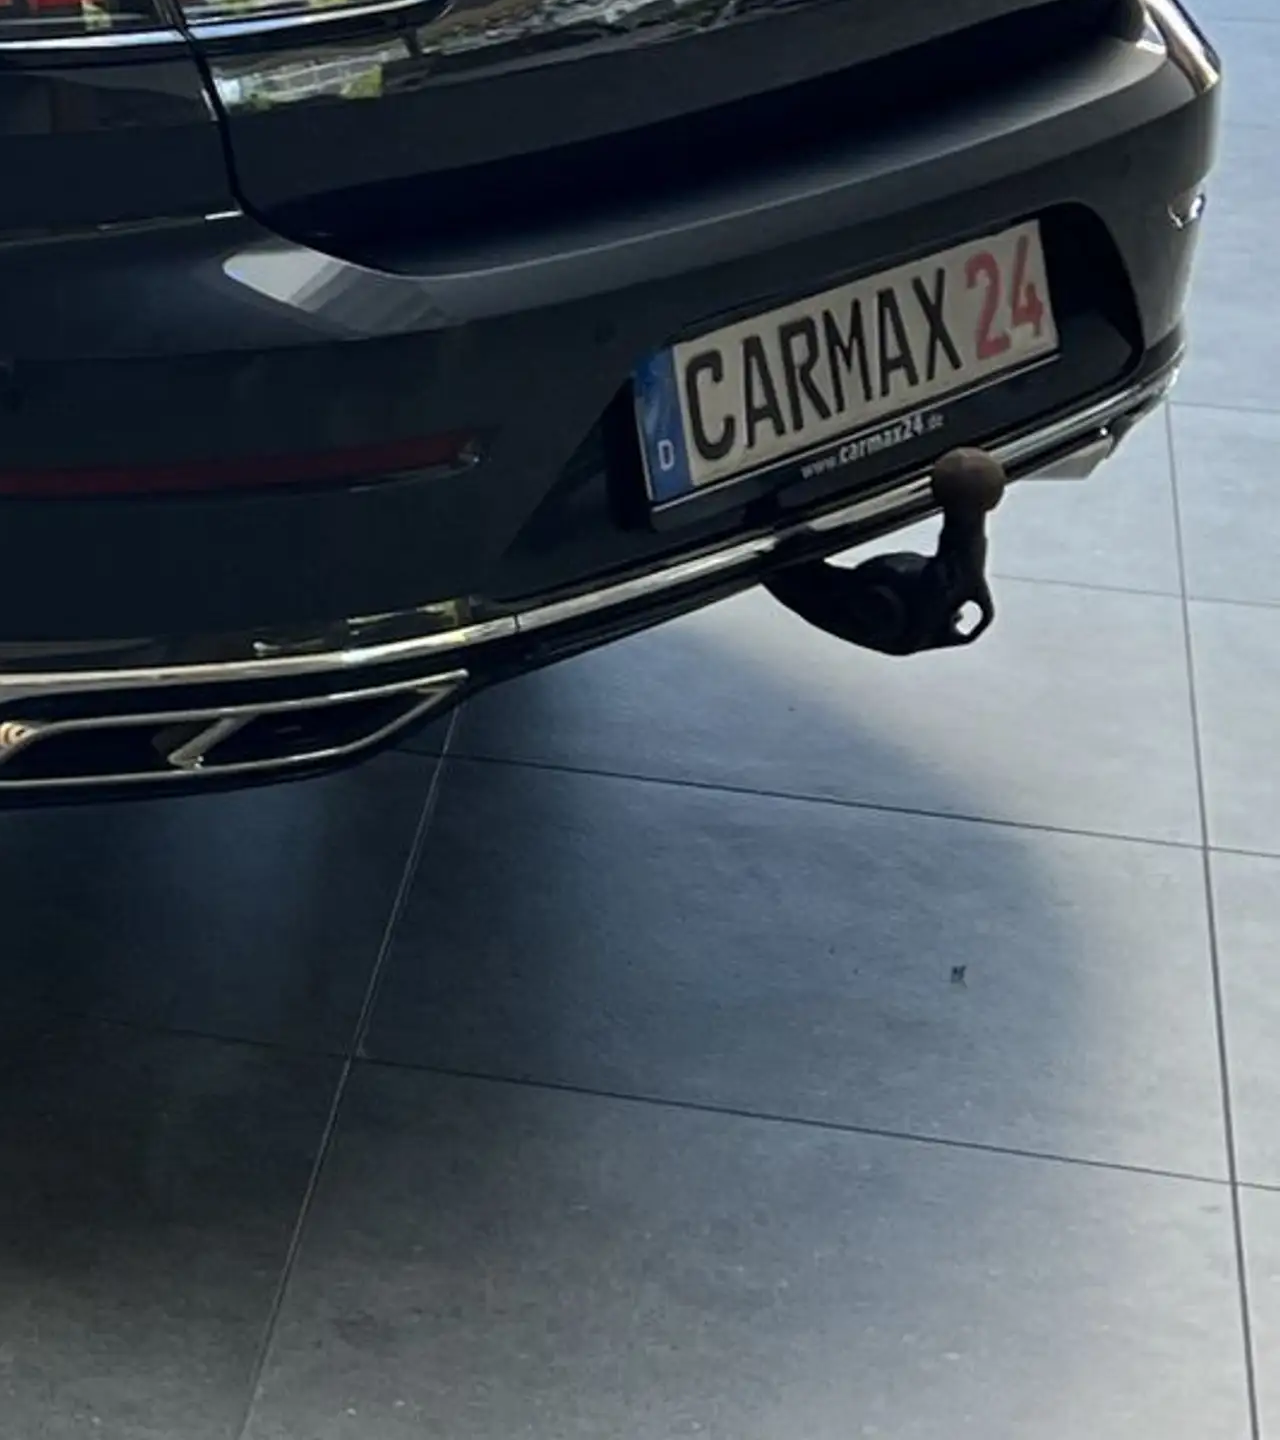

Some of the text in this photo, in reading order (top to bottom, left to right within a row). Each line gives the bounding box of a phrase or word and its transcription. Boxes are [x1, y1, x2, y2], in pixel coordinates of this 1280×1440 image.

[685, 235, 1044, 460] CARMAX 24
[658, 440, 675, 471] D
